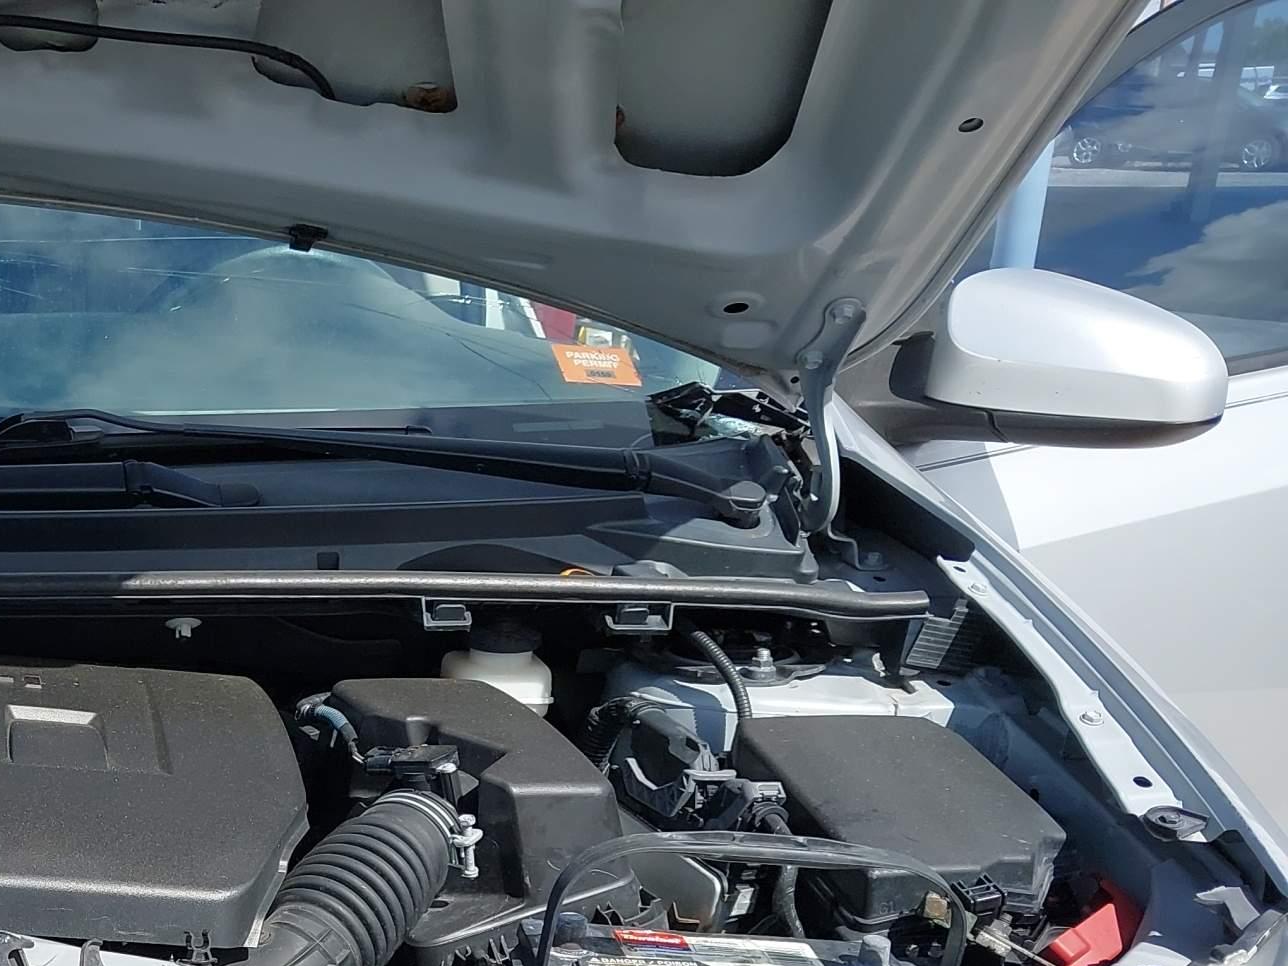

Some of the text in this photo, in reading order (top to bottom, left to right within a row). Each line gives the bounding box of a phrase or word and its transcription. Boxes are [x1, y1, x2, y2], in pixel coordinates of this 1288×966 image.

[565, 351, 619, 362] PARKING
[573, 360, 618, 368] PERMIT
[601, 957, 646, 966] DANGER
